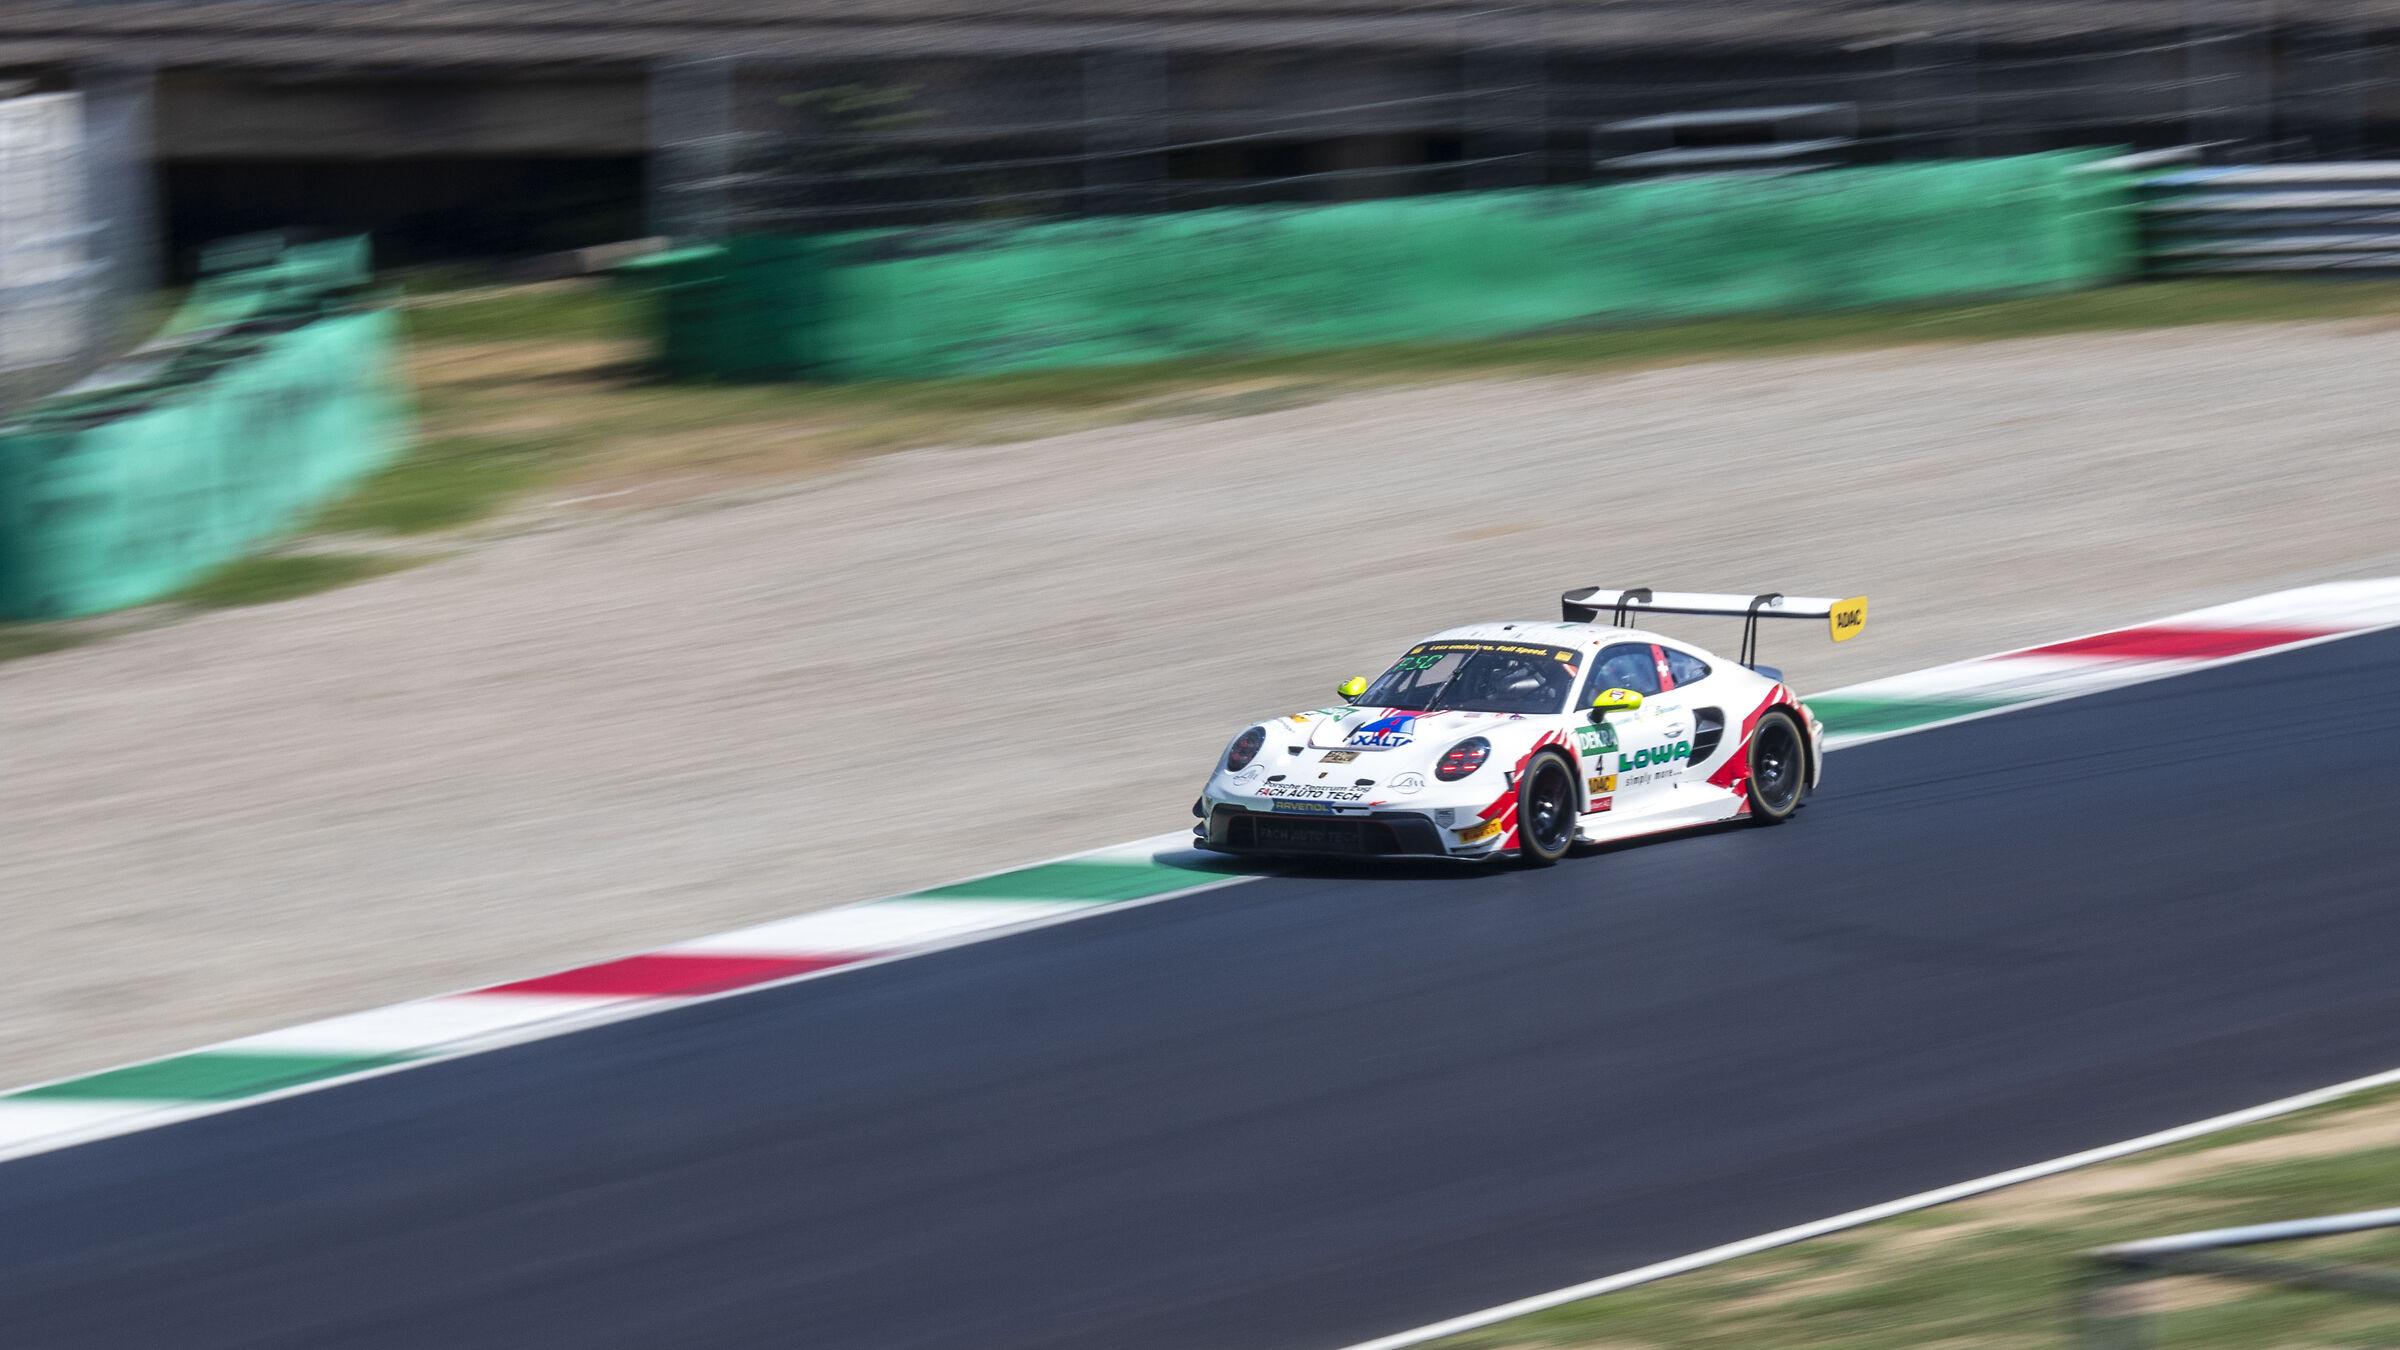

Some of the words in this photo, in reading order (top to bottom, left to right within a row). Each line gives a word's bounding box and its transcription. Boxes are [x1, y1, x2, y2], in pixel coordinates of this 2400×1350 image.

[1836, 608, 1862, 628] ADAC
[1579, 730, 1617, 750] DEKRA
[1618, 740, 1691, 772] LOWA
[1595, 755, 1603, 775] 4
[1263, 780, 1301, 790] Porsche
[1303, 784, 1347, 792] Zentrum
[1625, 771, 1651, 786] simply
[1255, 788, 1289, 797] FACH
[1287, 789, 1323, 798] AUTO
[1326, 791, 1363, 801] TECH
[1276, 801, 1330, 812] RAVENOL
